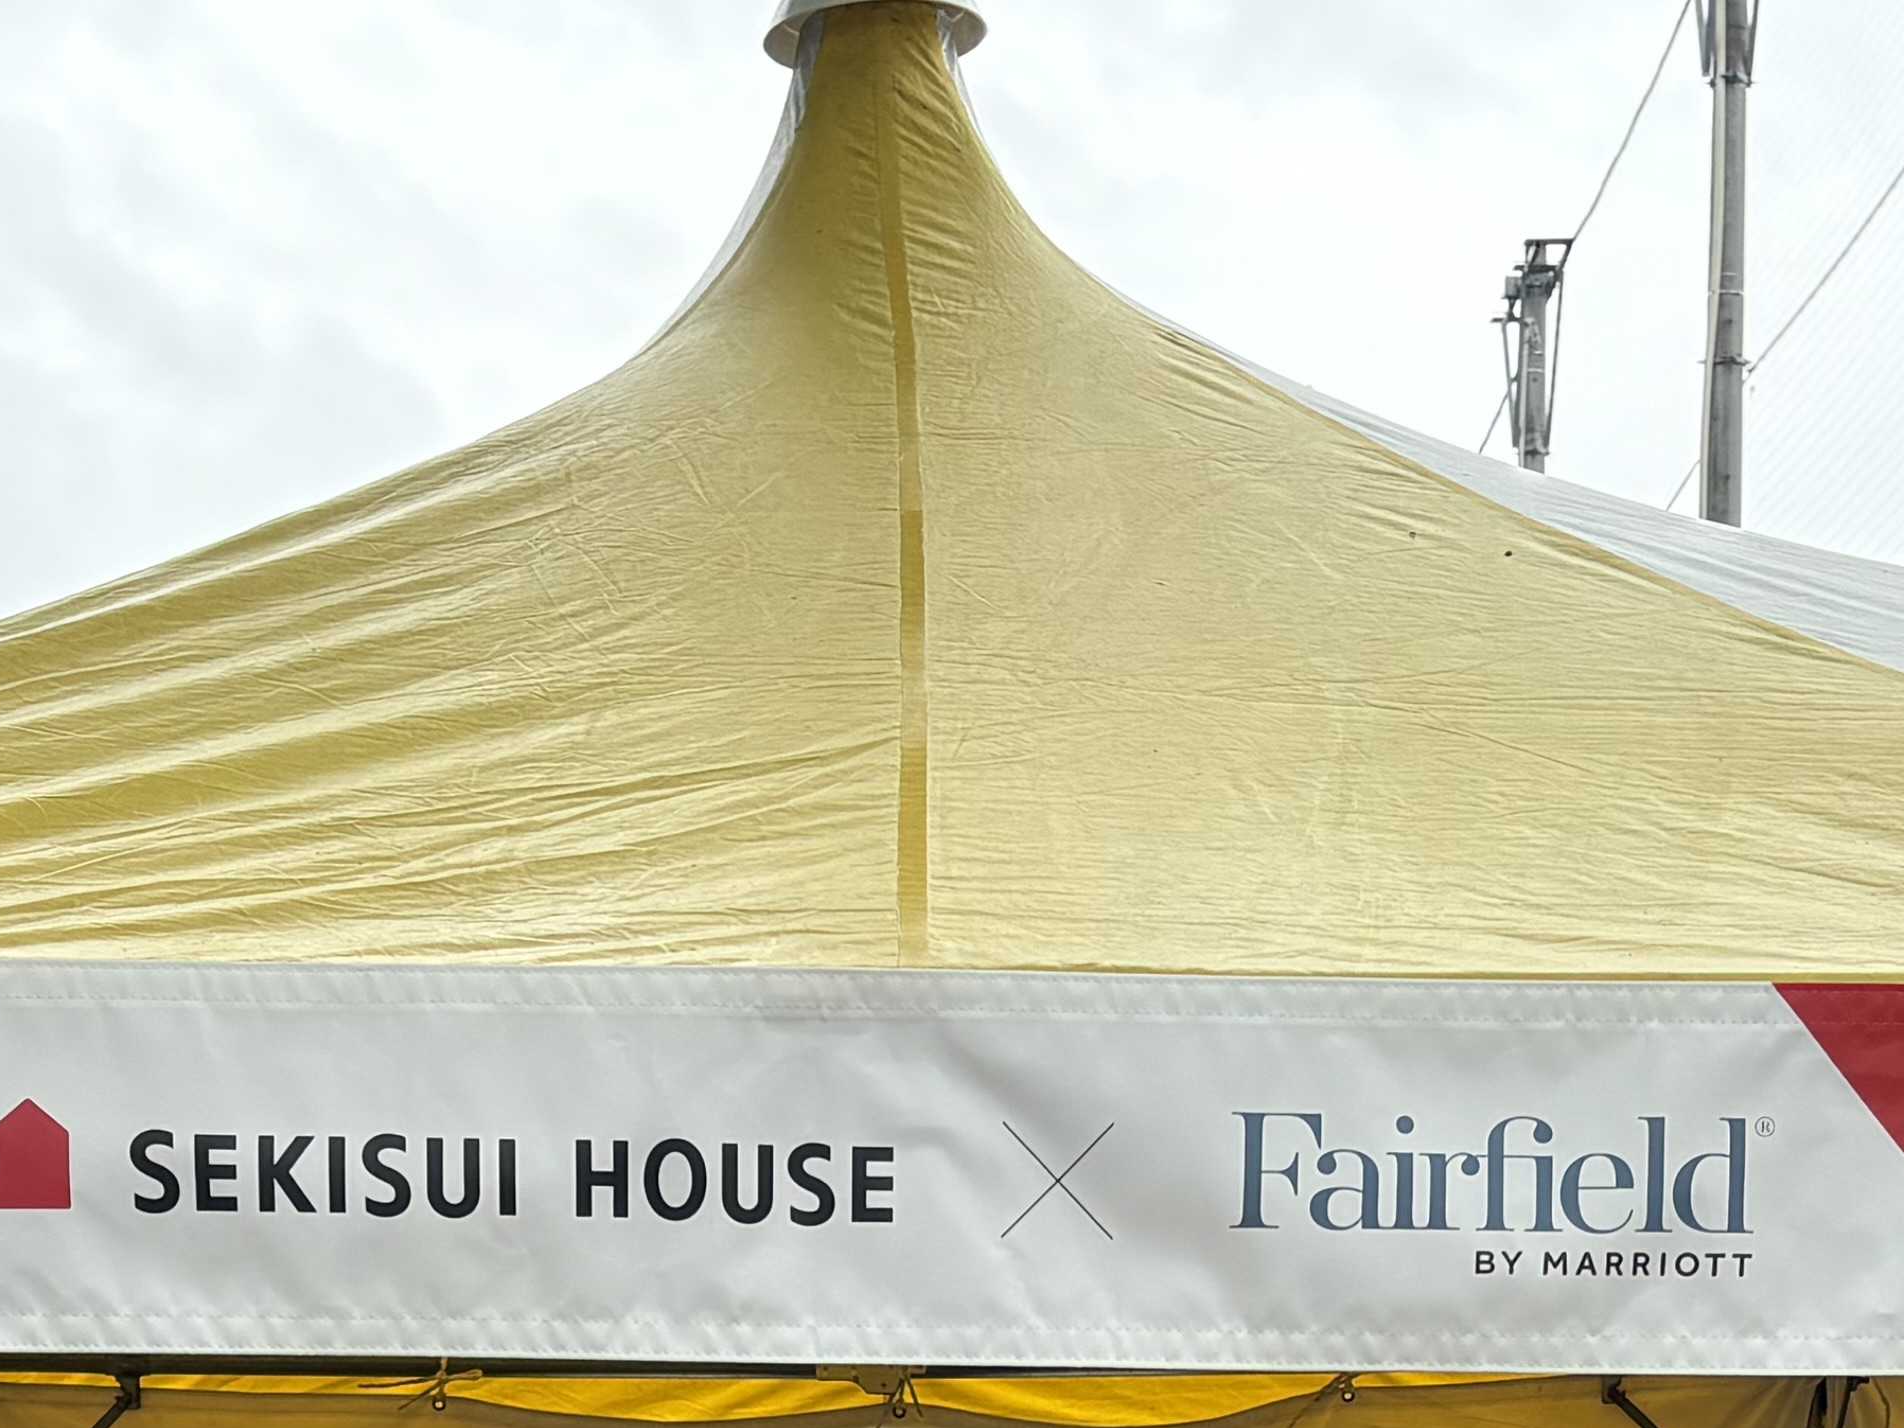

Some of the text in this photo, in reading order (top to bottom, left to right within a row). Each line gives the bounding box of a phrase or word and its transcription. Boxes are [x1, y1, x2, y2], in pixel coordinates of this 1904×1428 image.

[129, 1129, 518, 1216] SEKISUI
[574, 1137, 896, 1225] HOUSE
[1474, 1250, 1753, 1279] BY MARRIOTT
